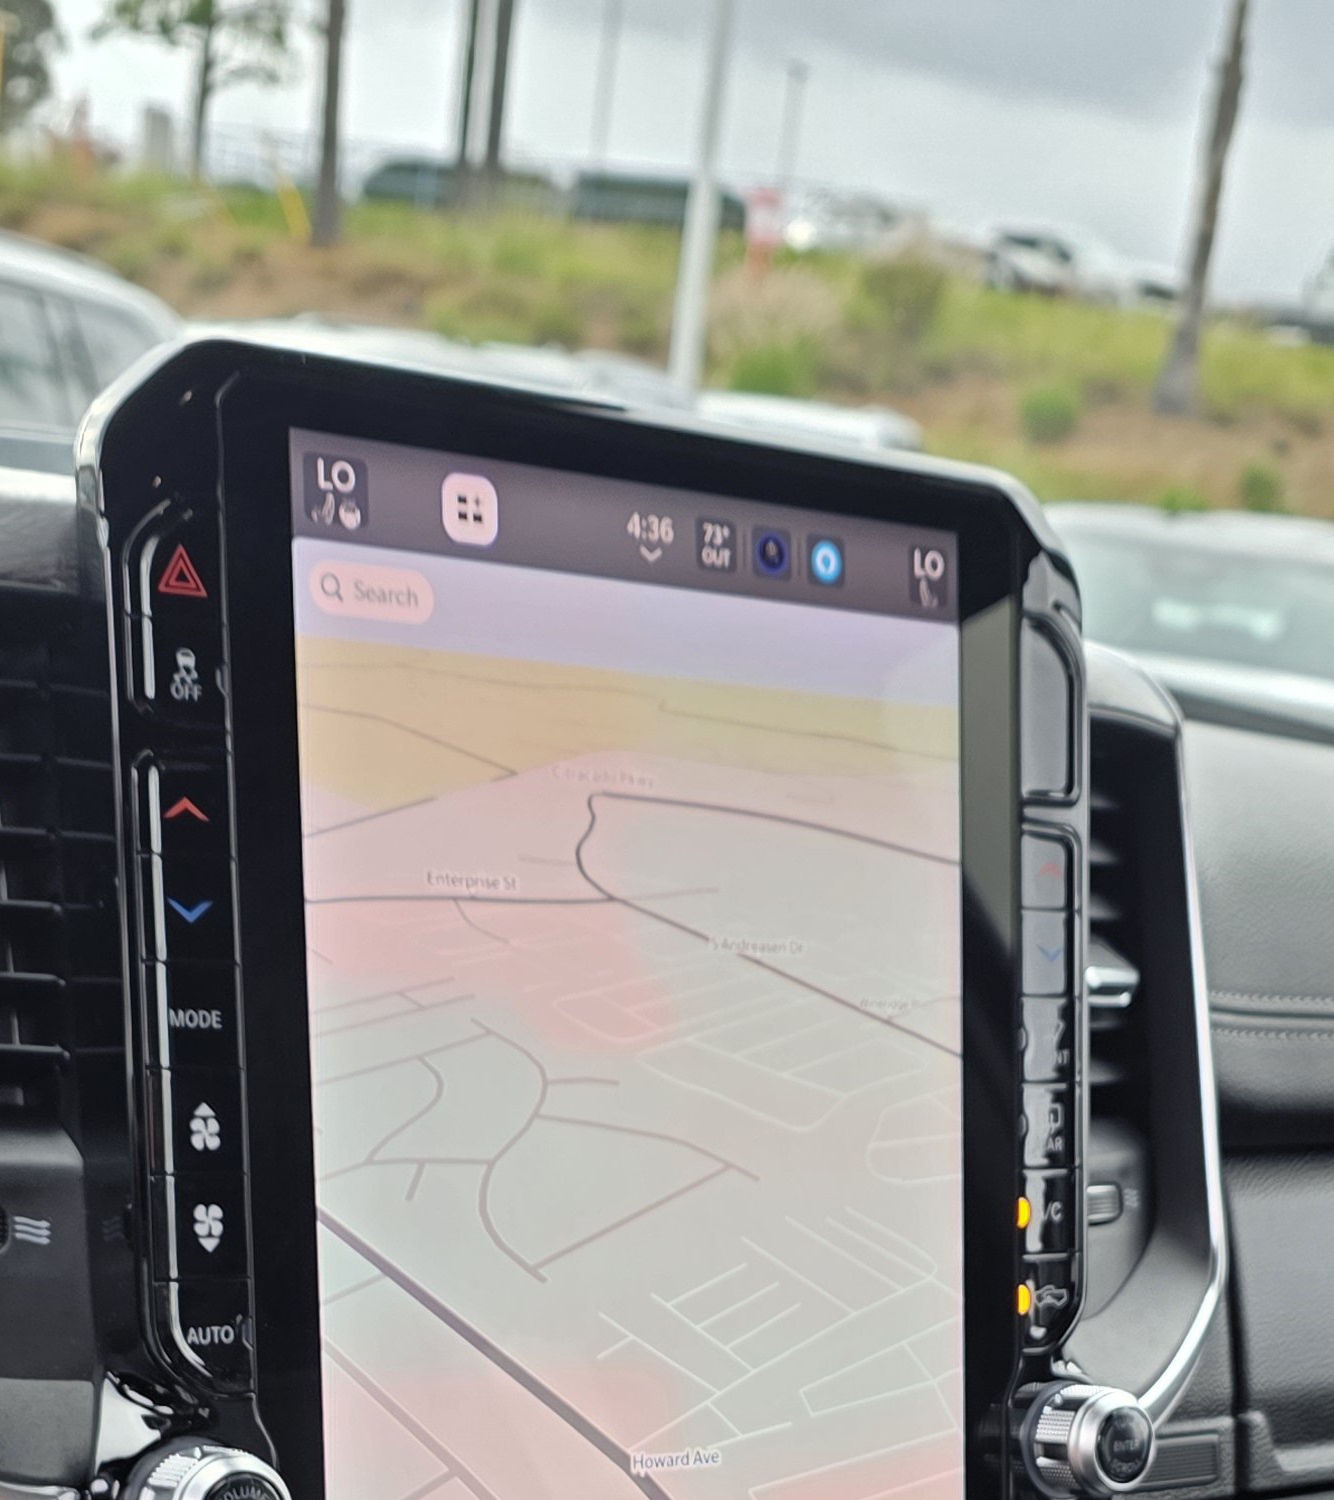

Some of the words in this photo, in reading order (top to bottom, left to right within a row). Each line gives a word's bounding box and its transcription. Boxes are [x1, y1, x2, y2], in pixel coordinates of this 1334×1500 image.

[316, 456, 356, 494] LO
[626, 511, 675, 546] 4:36
[700, 545, 731, 569] OUT
[913, 546, 945, 582] LO
[353, 578, 419, 609] Search
[169, 682, 204, 703] OFF
[426, 870, 500, 890] Enterprise
[502, 876, 517, 891] St
[788, 941, 804, 954] Dr
[168, 1007, 224, 1030] MODE
[186, 1324, 235, 1346] AUTO
[632, 1451, 690, 1470] Howard
[692, 1449, 720, 1466] Ave
